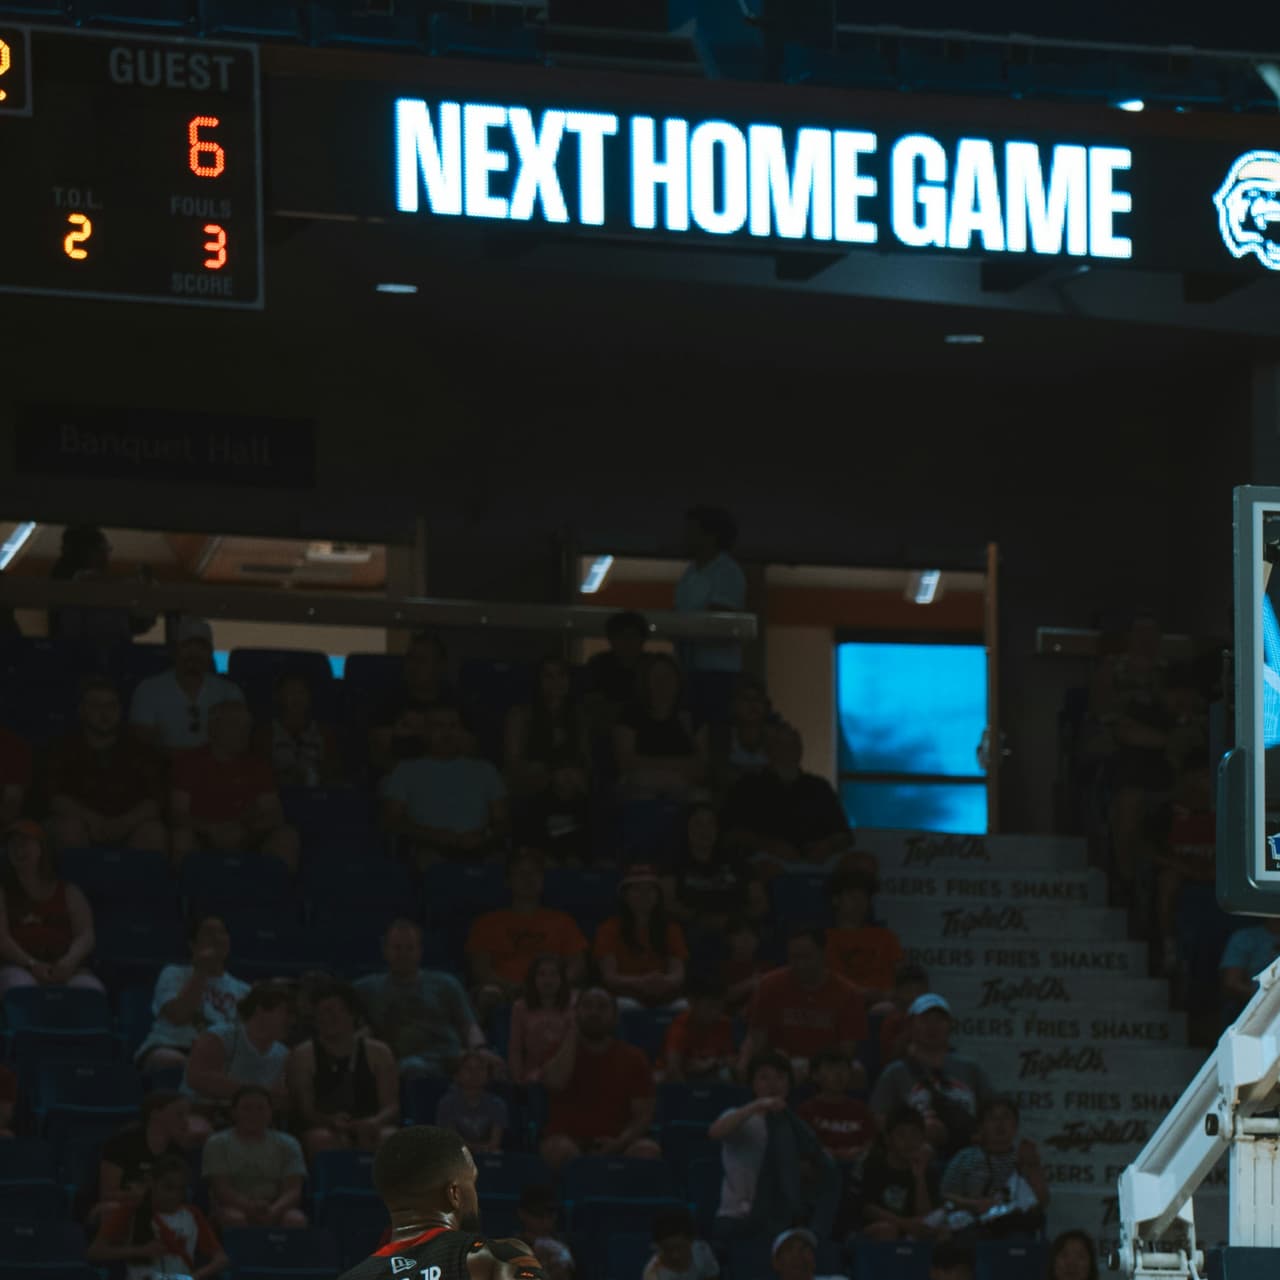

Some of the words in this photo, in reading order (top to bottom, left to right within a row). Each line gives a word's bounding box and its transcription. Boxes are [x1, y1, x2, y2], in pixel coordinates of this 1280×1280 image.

[109, 46, 235, 93] GUEST
[187, 115, 225, 178] 6
[396, 97, 617, 226] NEXT
[630, 116, 878, 244] HOME
[890, 133, 1133, 259] GAME
[170, 195, 232, 220] FOULS
[63, 212, 93, 261] 2
[203, 223, 227, 270] 3
[171, 272, 233, 296] SCORE
[59, 424, 194, 466] Banquet
[208, 434, 273, 467] Hall
[984, 951, 1041, 969] FRIES
[1050, 951, 1129, 970] SHAKES
[1024, 1018, 1081, 1038] FRIES
[1091, 1020, 1170, 1041] SHAKES
[1064, 1091, 1121, 1110] FRIES
[1132, 1093, 1176, 1111] SHA
